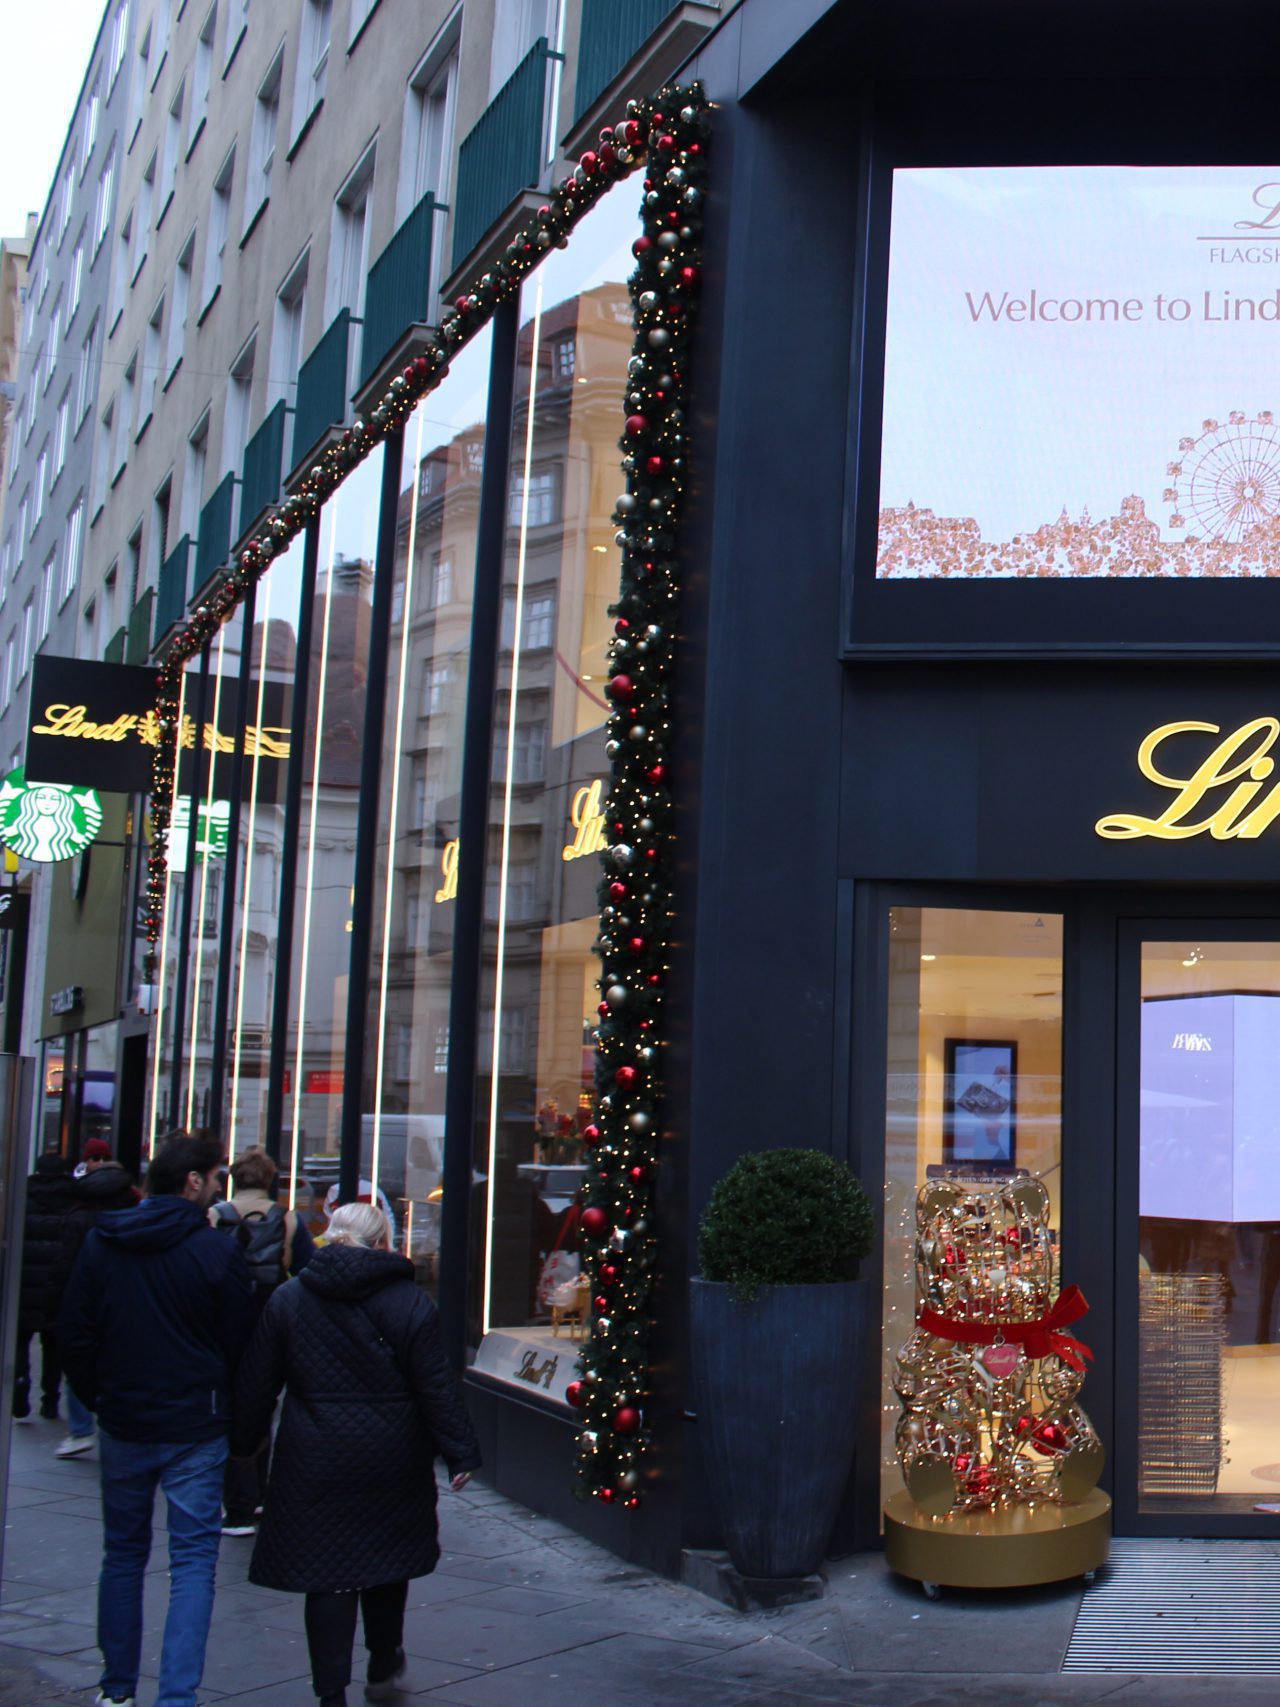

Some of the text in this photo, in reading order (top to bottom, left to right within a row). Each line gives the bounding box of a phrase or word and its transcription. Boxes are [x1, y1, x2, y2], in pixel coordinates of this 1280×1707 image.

[965, 289, 1143, 322] Welcome
[1154, 293, 1192, 322] to
[32, 702, 140, 744] Lindt
